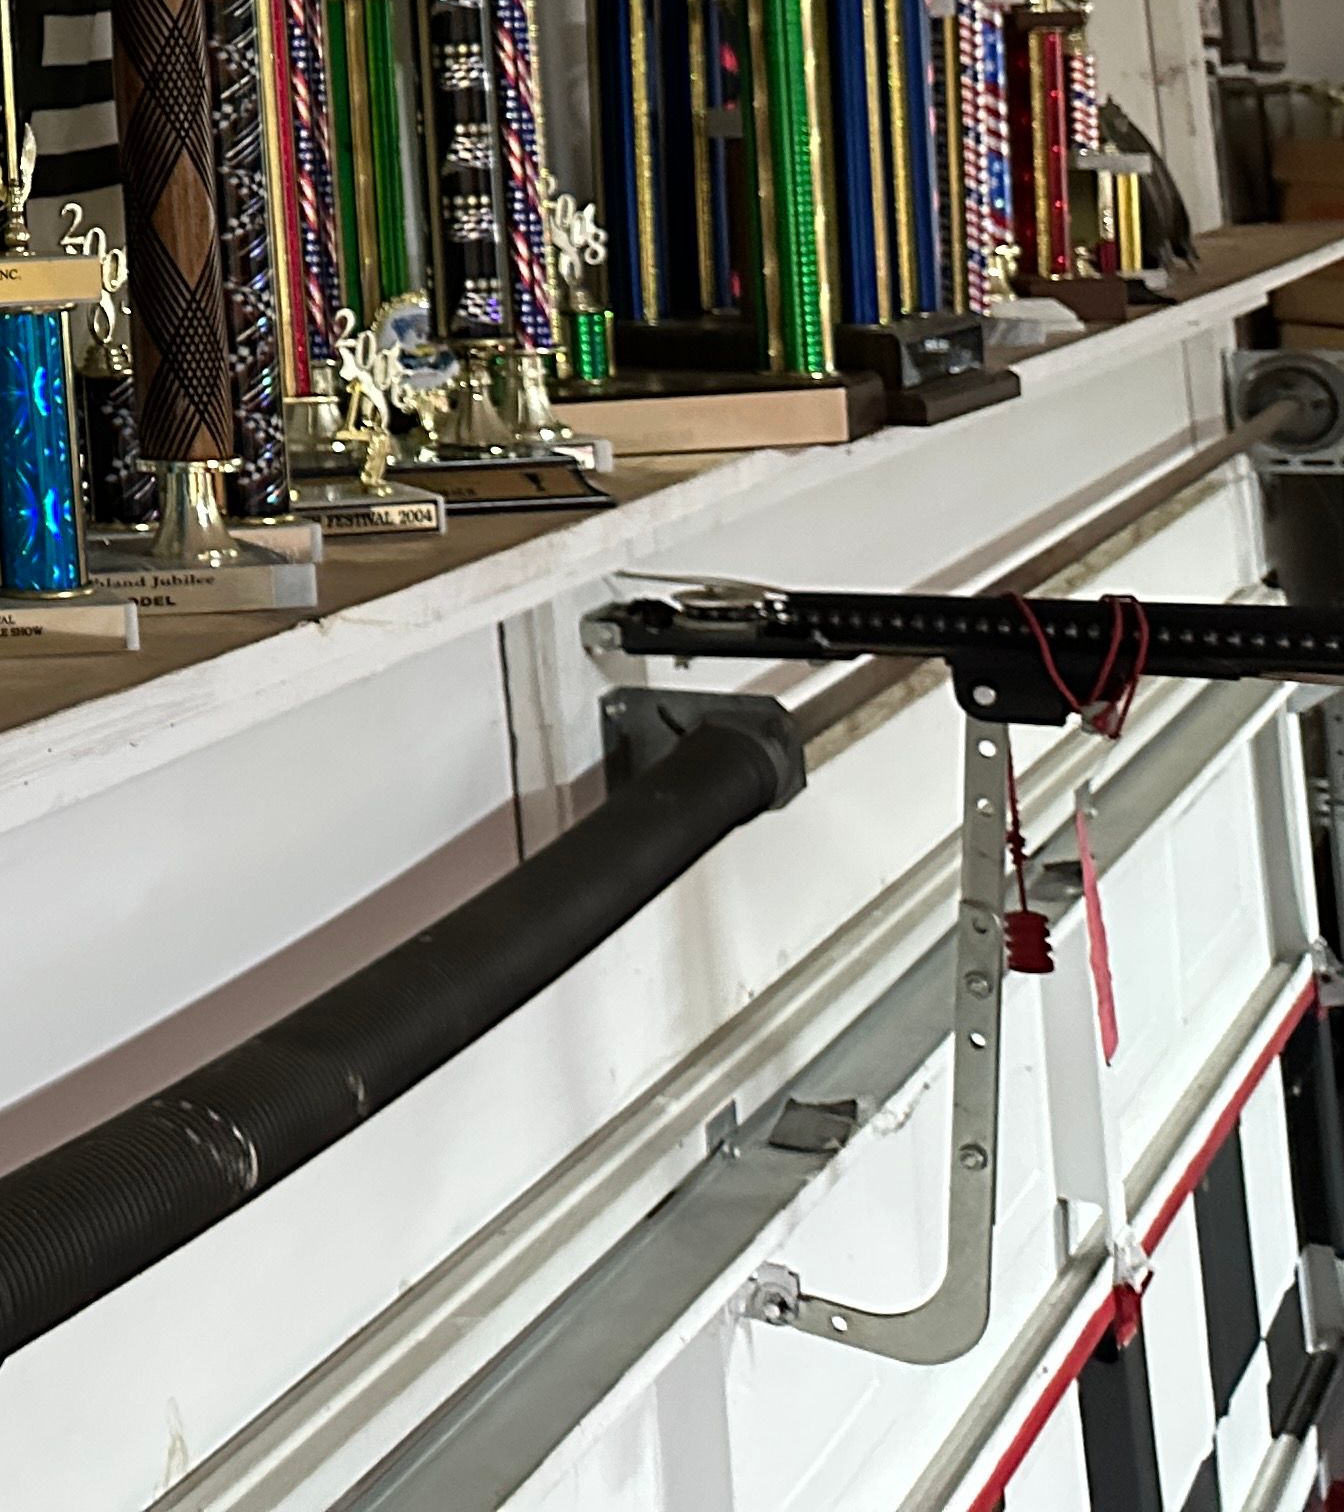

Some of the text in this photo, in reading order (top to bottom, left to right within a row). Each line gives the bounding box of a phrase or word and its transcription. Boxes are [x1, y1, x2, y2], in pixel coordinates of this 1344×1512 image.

[325, 510, 394, 528] FESTIVAL
[398, 508, 433, 524] 2004
[151, 574, 215, 588] Jubilee
[11, 625, 43, 637] SHOW
